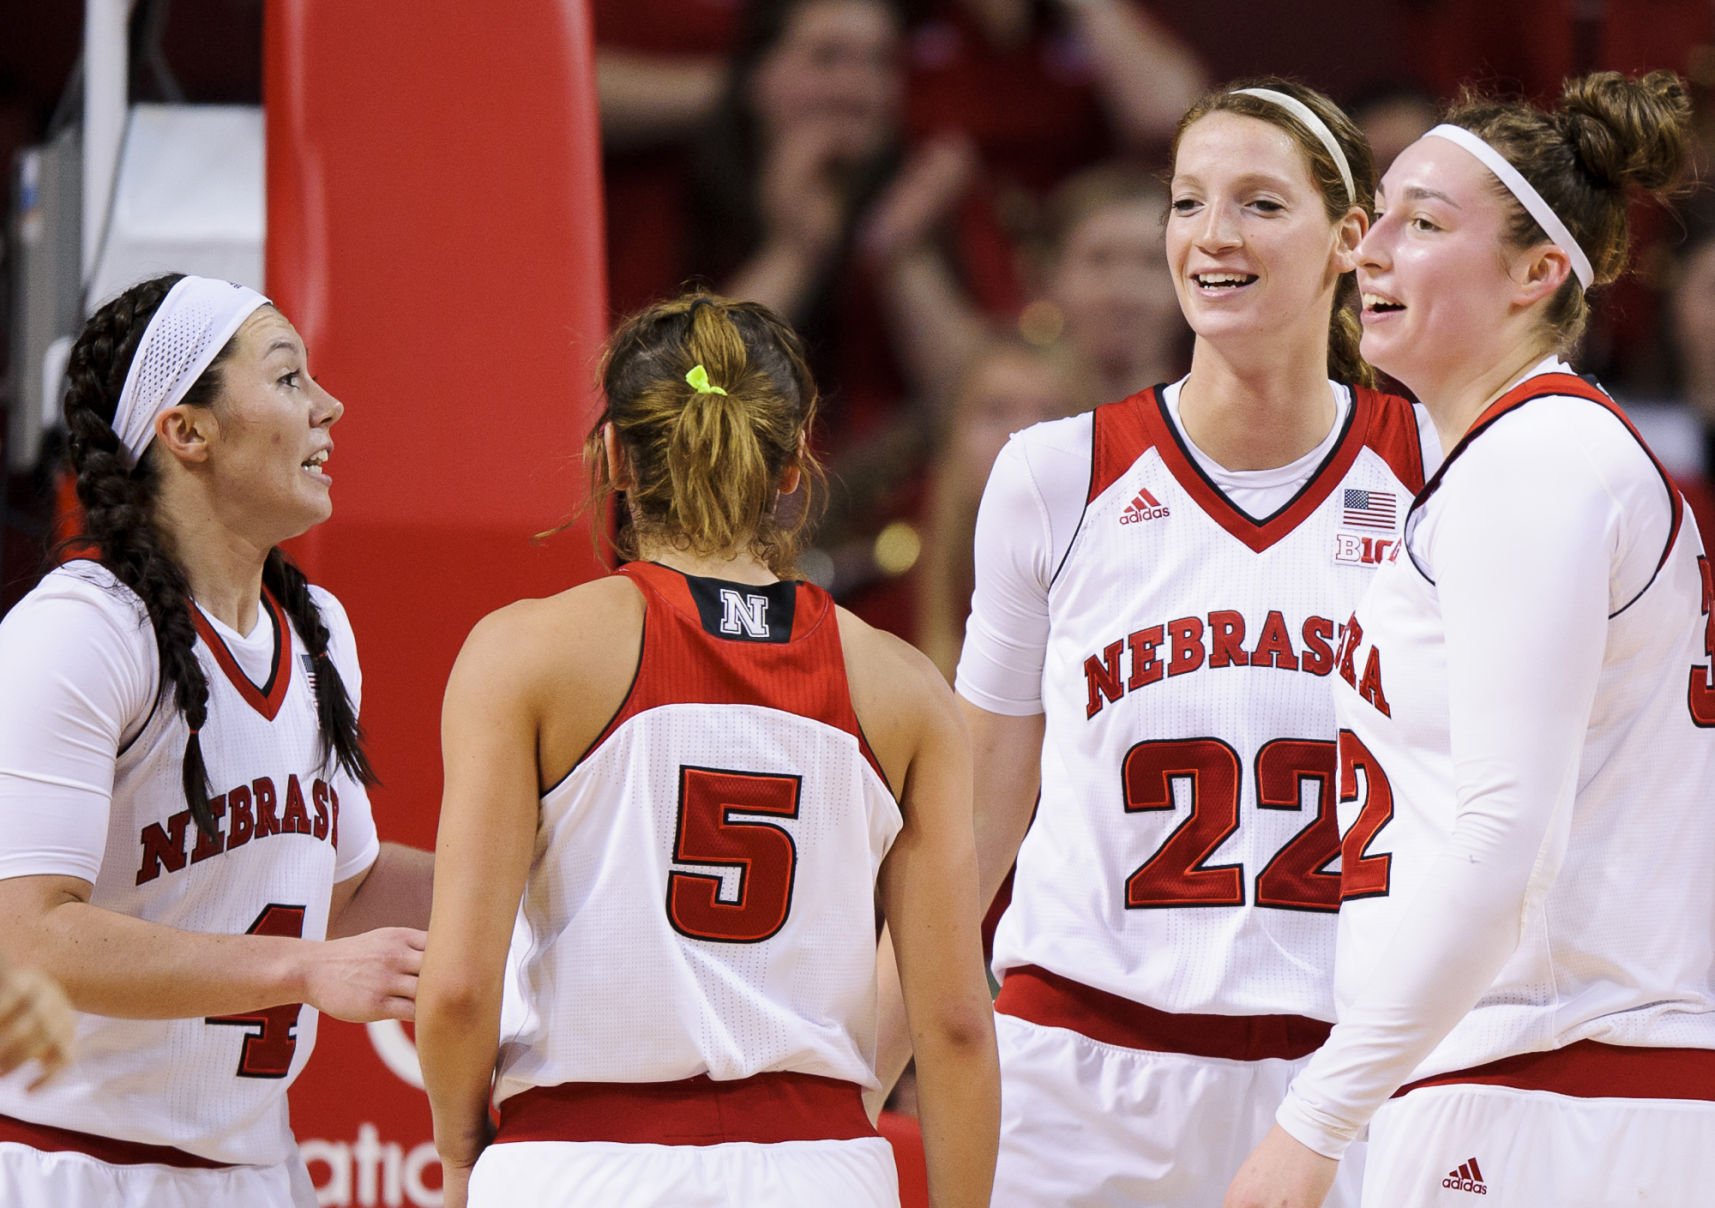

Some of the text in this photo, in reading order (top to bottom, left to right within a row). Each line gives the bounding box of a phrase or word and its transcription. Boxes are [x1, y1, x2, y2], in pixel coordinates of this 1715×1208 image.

[1119, 506, 1170, 525] adidas
[719, 588, 770, 638] N
[1084, 609, 1345, 721] NEBRAS
[665, 764, 803, 944] 5
[1121, 736, 1343, 914] 22
[204, 903, 307, 1079] 4
[1442, 1177, 1488, 1195] adidas
